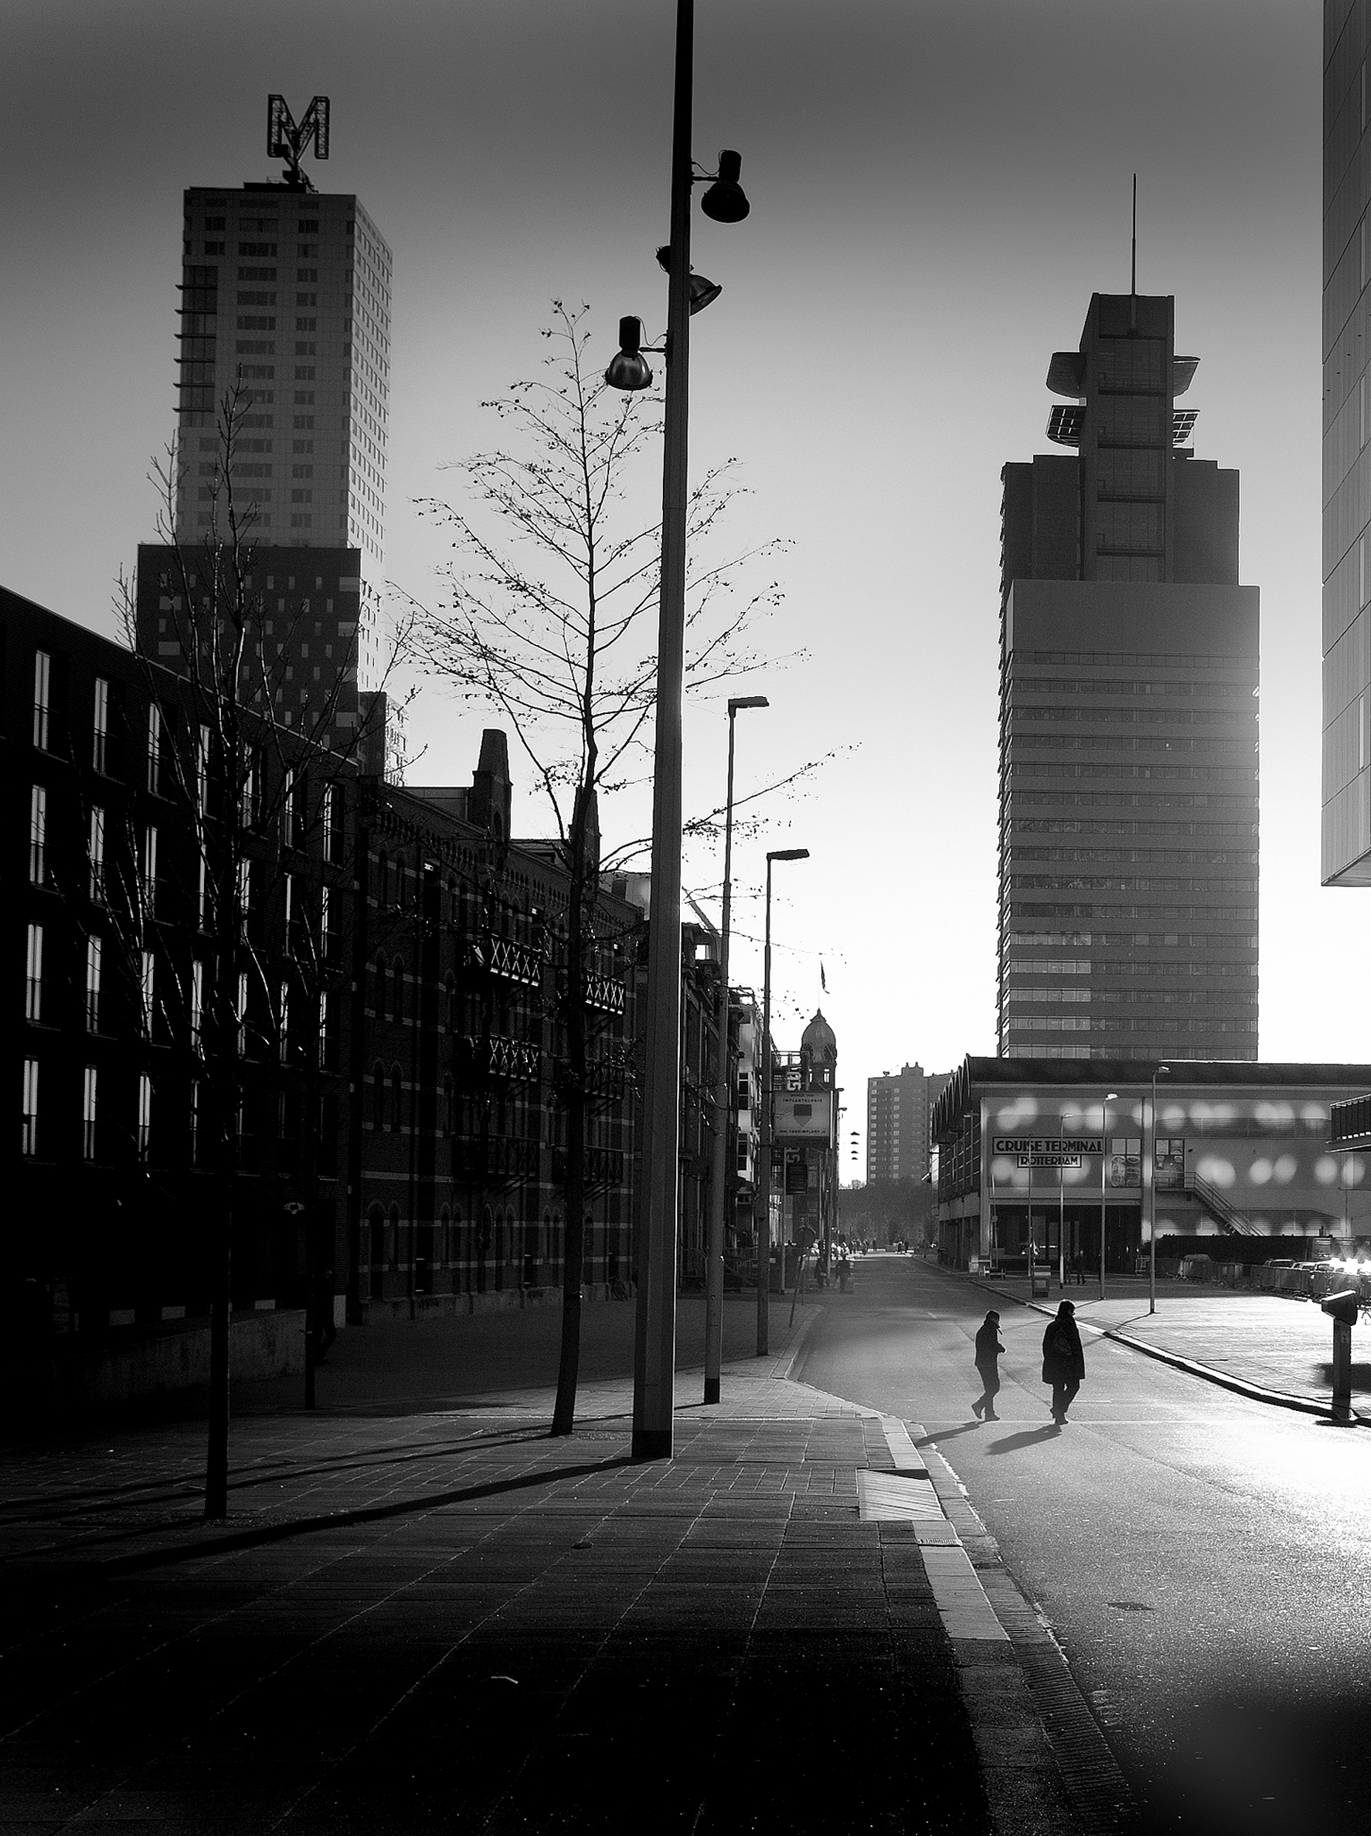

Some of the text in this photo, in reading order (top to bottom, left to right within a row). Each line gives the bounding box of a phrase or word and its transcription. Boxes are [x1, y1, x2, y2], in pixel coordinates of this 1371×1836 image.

[267, 94, 330, 159] M
[996, 1140, 1103, 1152] CRUISE TERMINAL
[1020, 1156, 1078, 1165] ROTTERDAM
